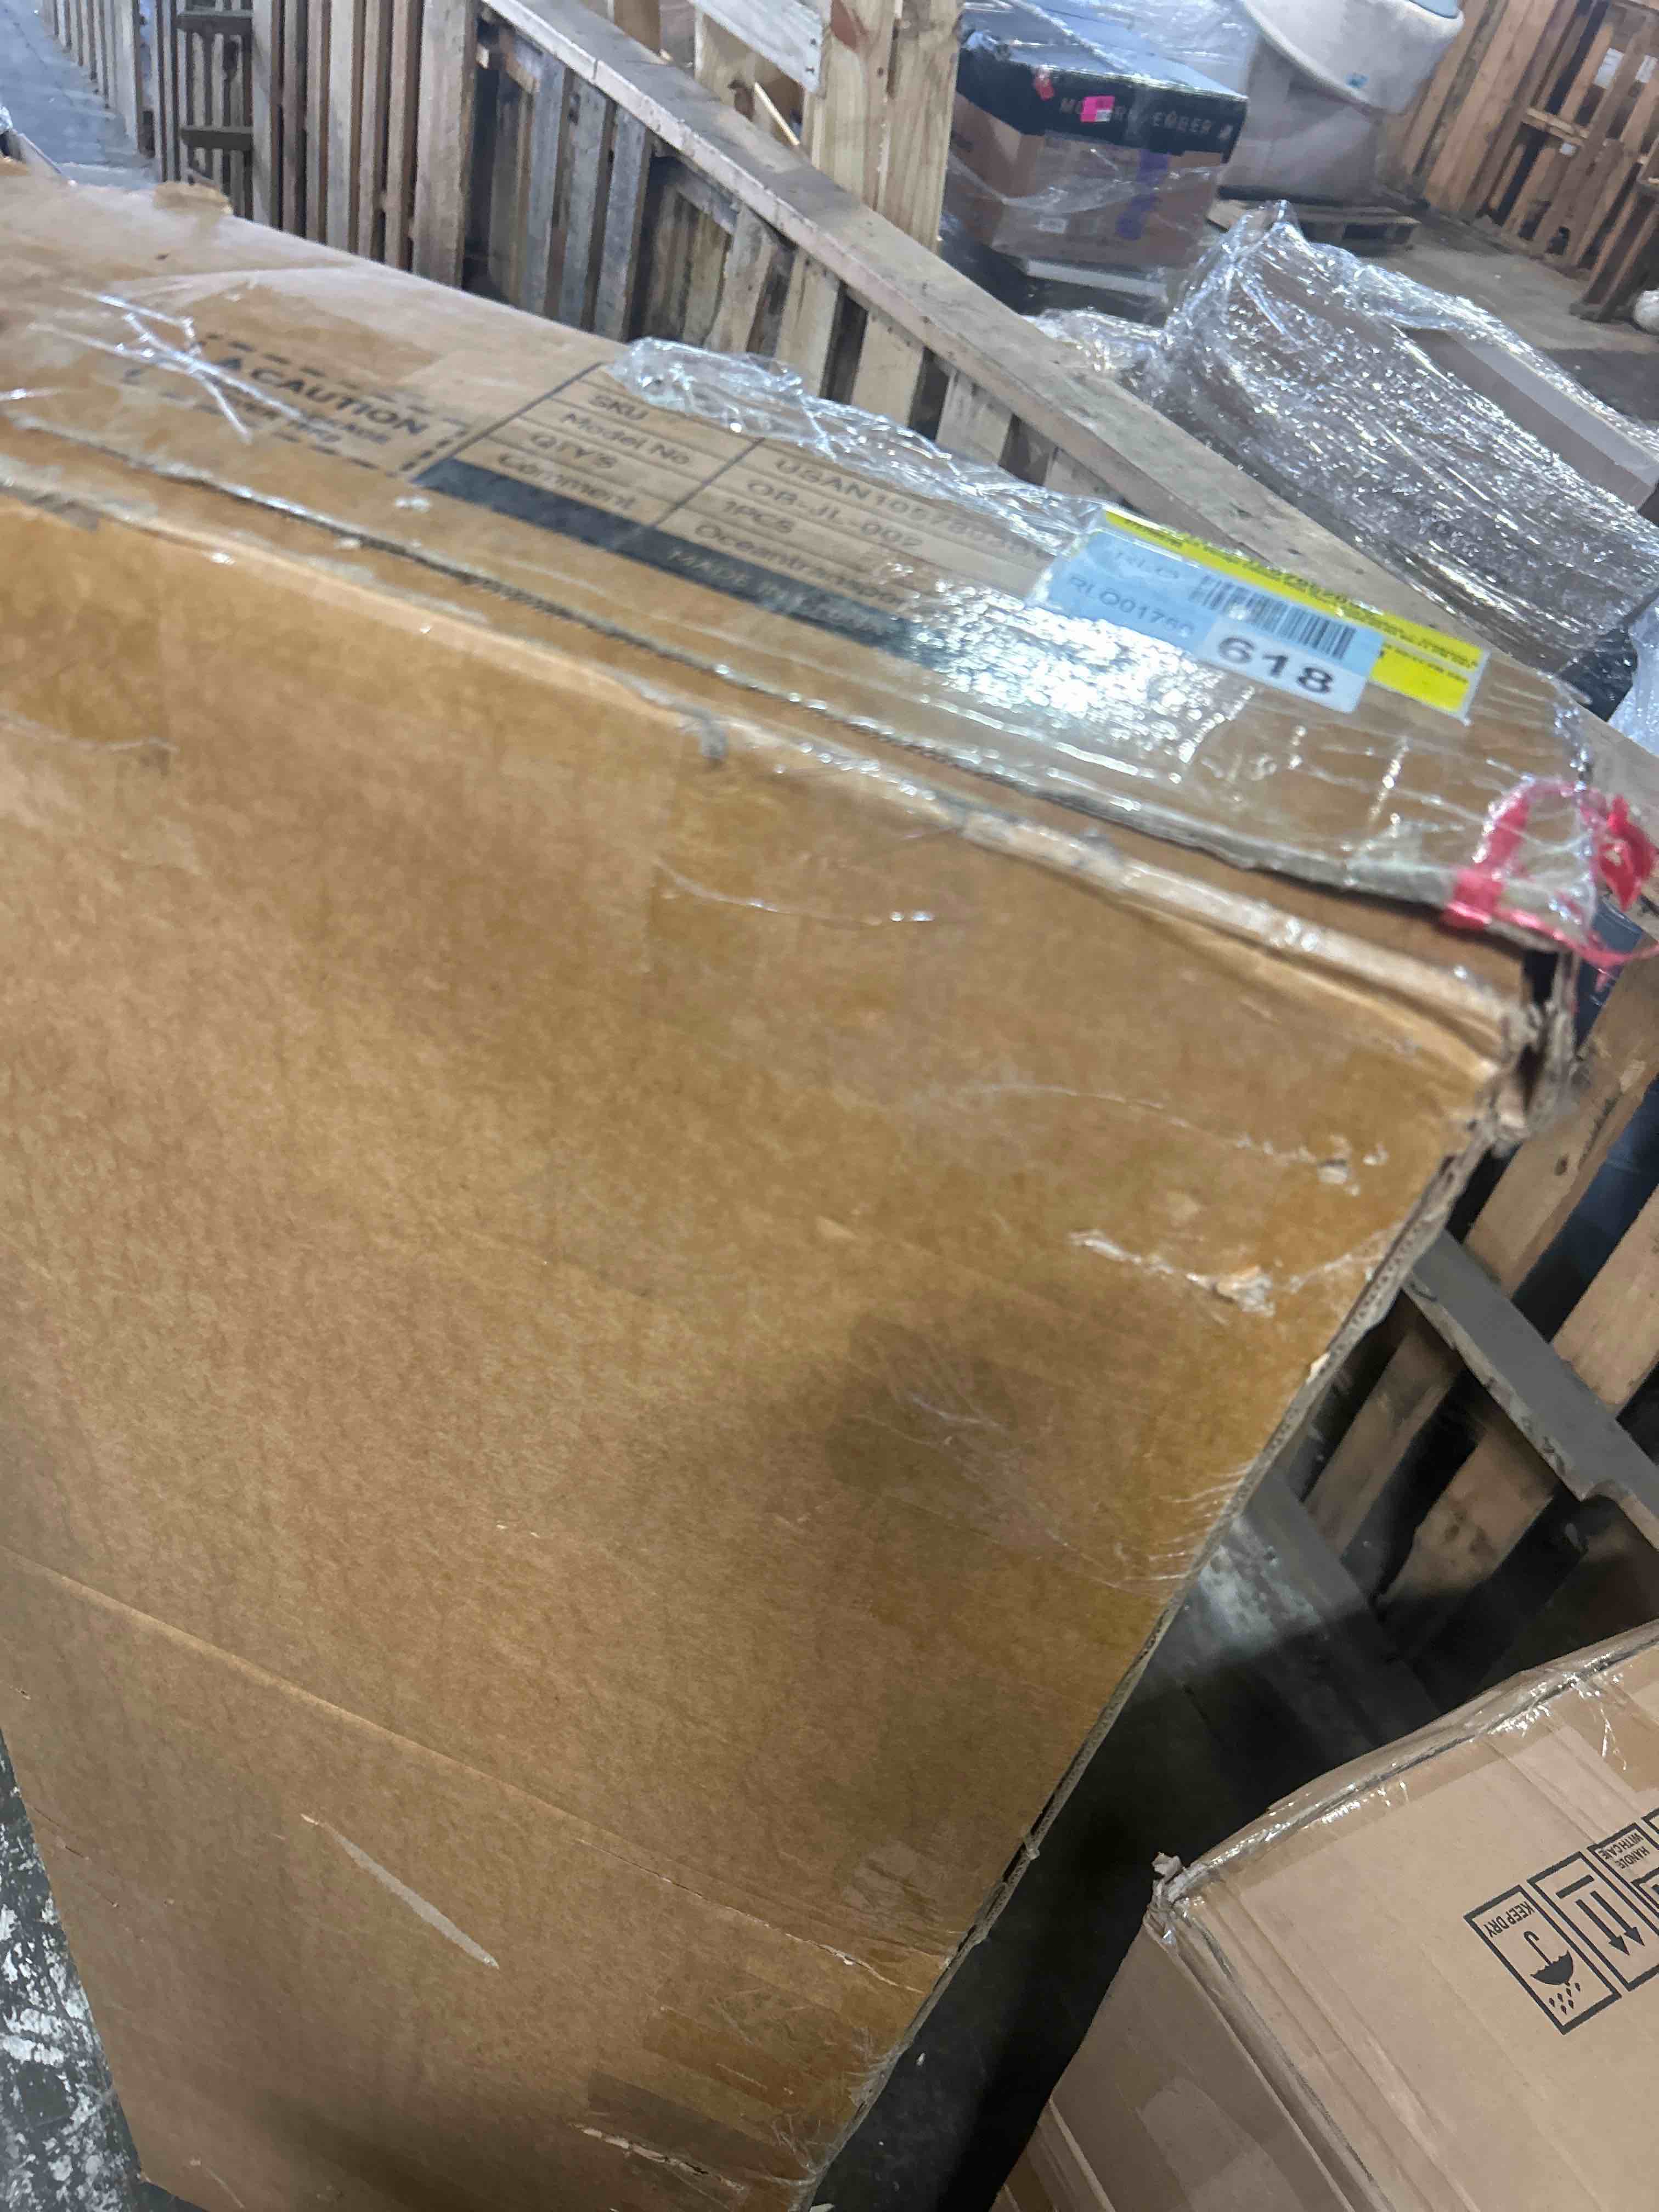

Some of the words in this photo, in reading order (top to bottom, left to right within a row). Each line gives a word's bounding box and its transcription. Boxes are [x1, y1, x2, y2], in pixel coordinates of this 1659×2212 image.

[250, 368, 430, 436] CAUTION
[588, 394, 648, 420] SKU
[1217, 635, 1335, 695] 618
[1615, 1846, 1651, 1869] HANDLE
[1505, 1901, 1536, 1925] KEEP
[1483, 1915, 1510, 1938] DRY
